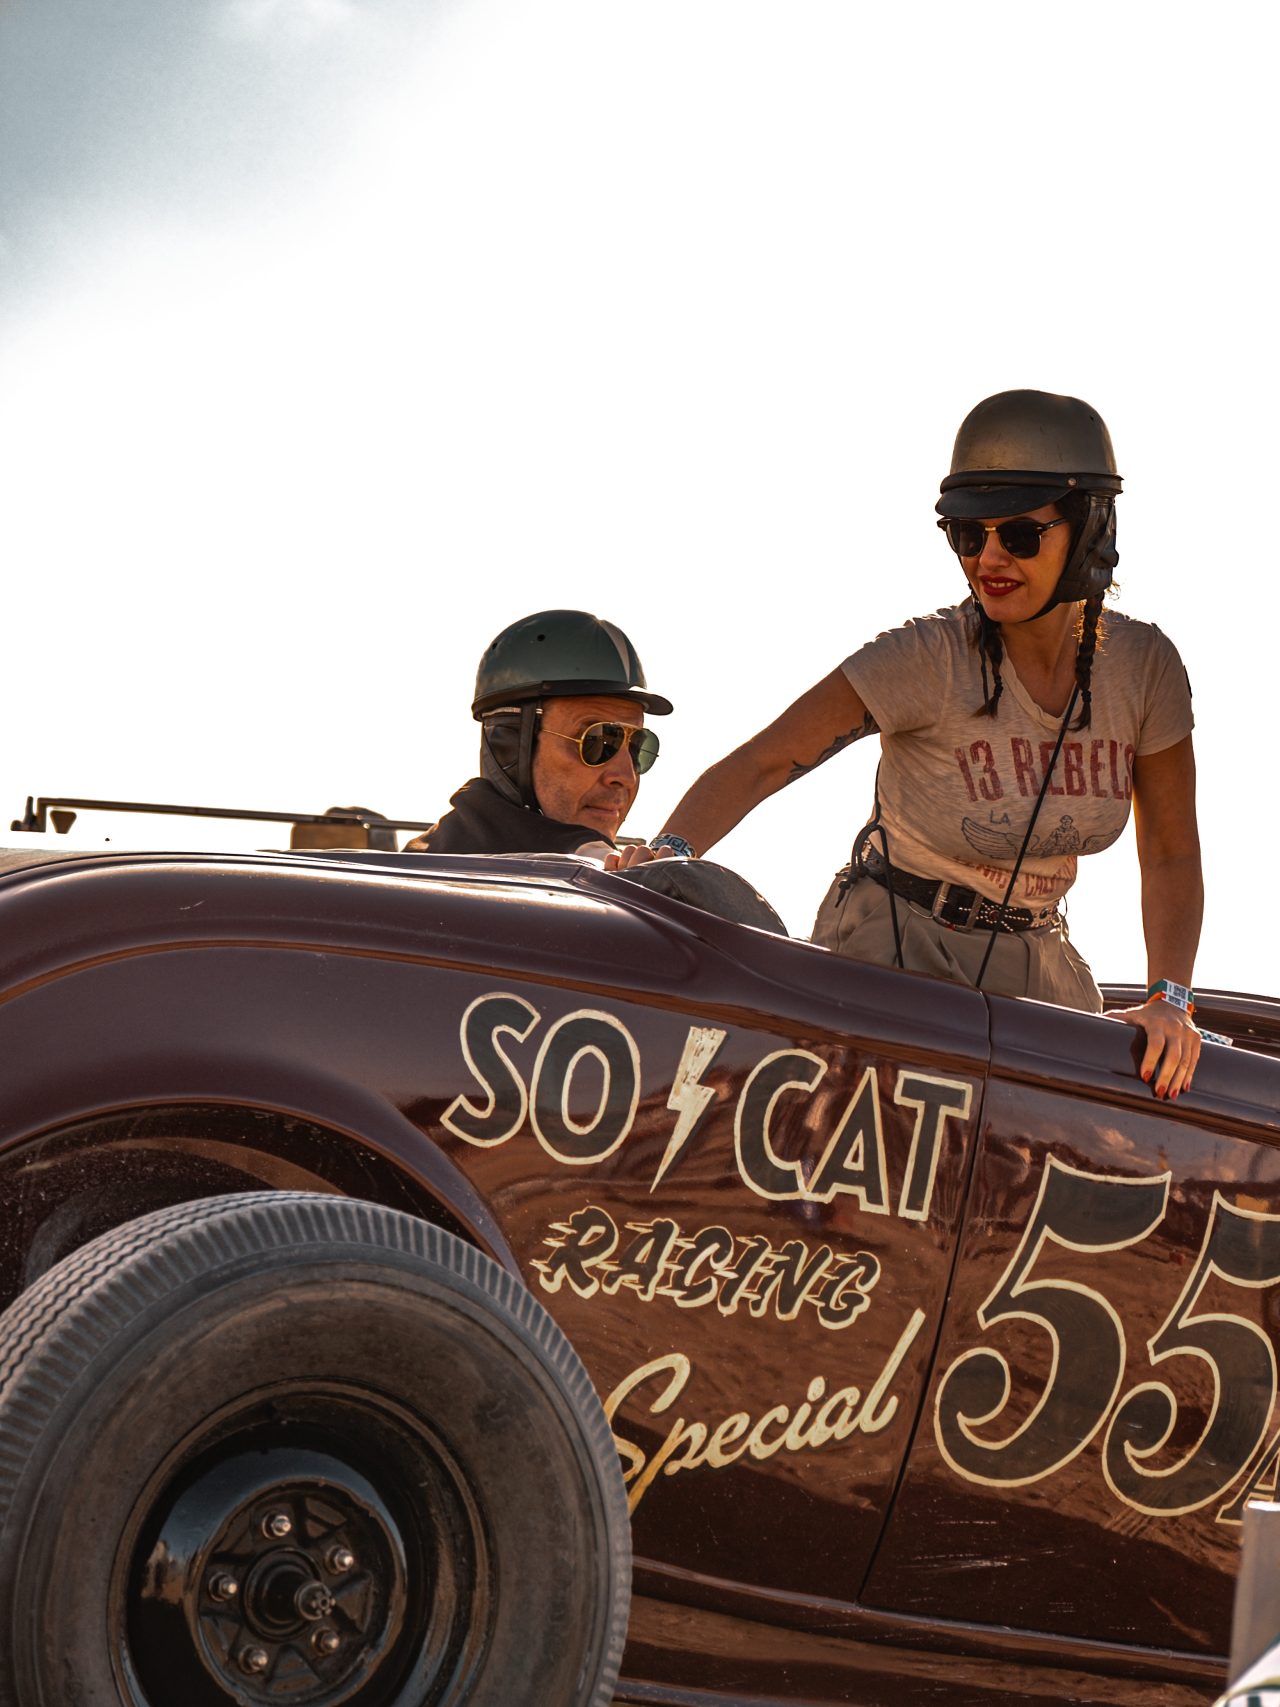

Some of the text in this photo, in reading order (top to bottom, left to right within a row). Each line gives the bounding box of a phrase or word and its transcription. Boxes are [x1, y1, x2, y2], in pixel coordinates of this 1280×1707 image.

[955, 737, 1134, 801] 13 REBELS
[440, 991, 973, 1221] SO CAT
[529, 1205, 881, 1329] RACING
[606, 1308, 926, 1517] Special
